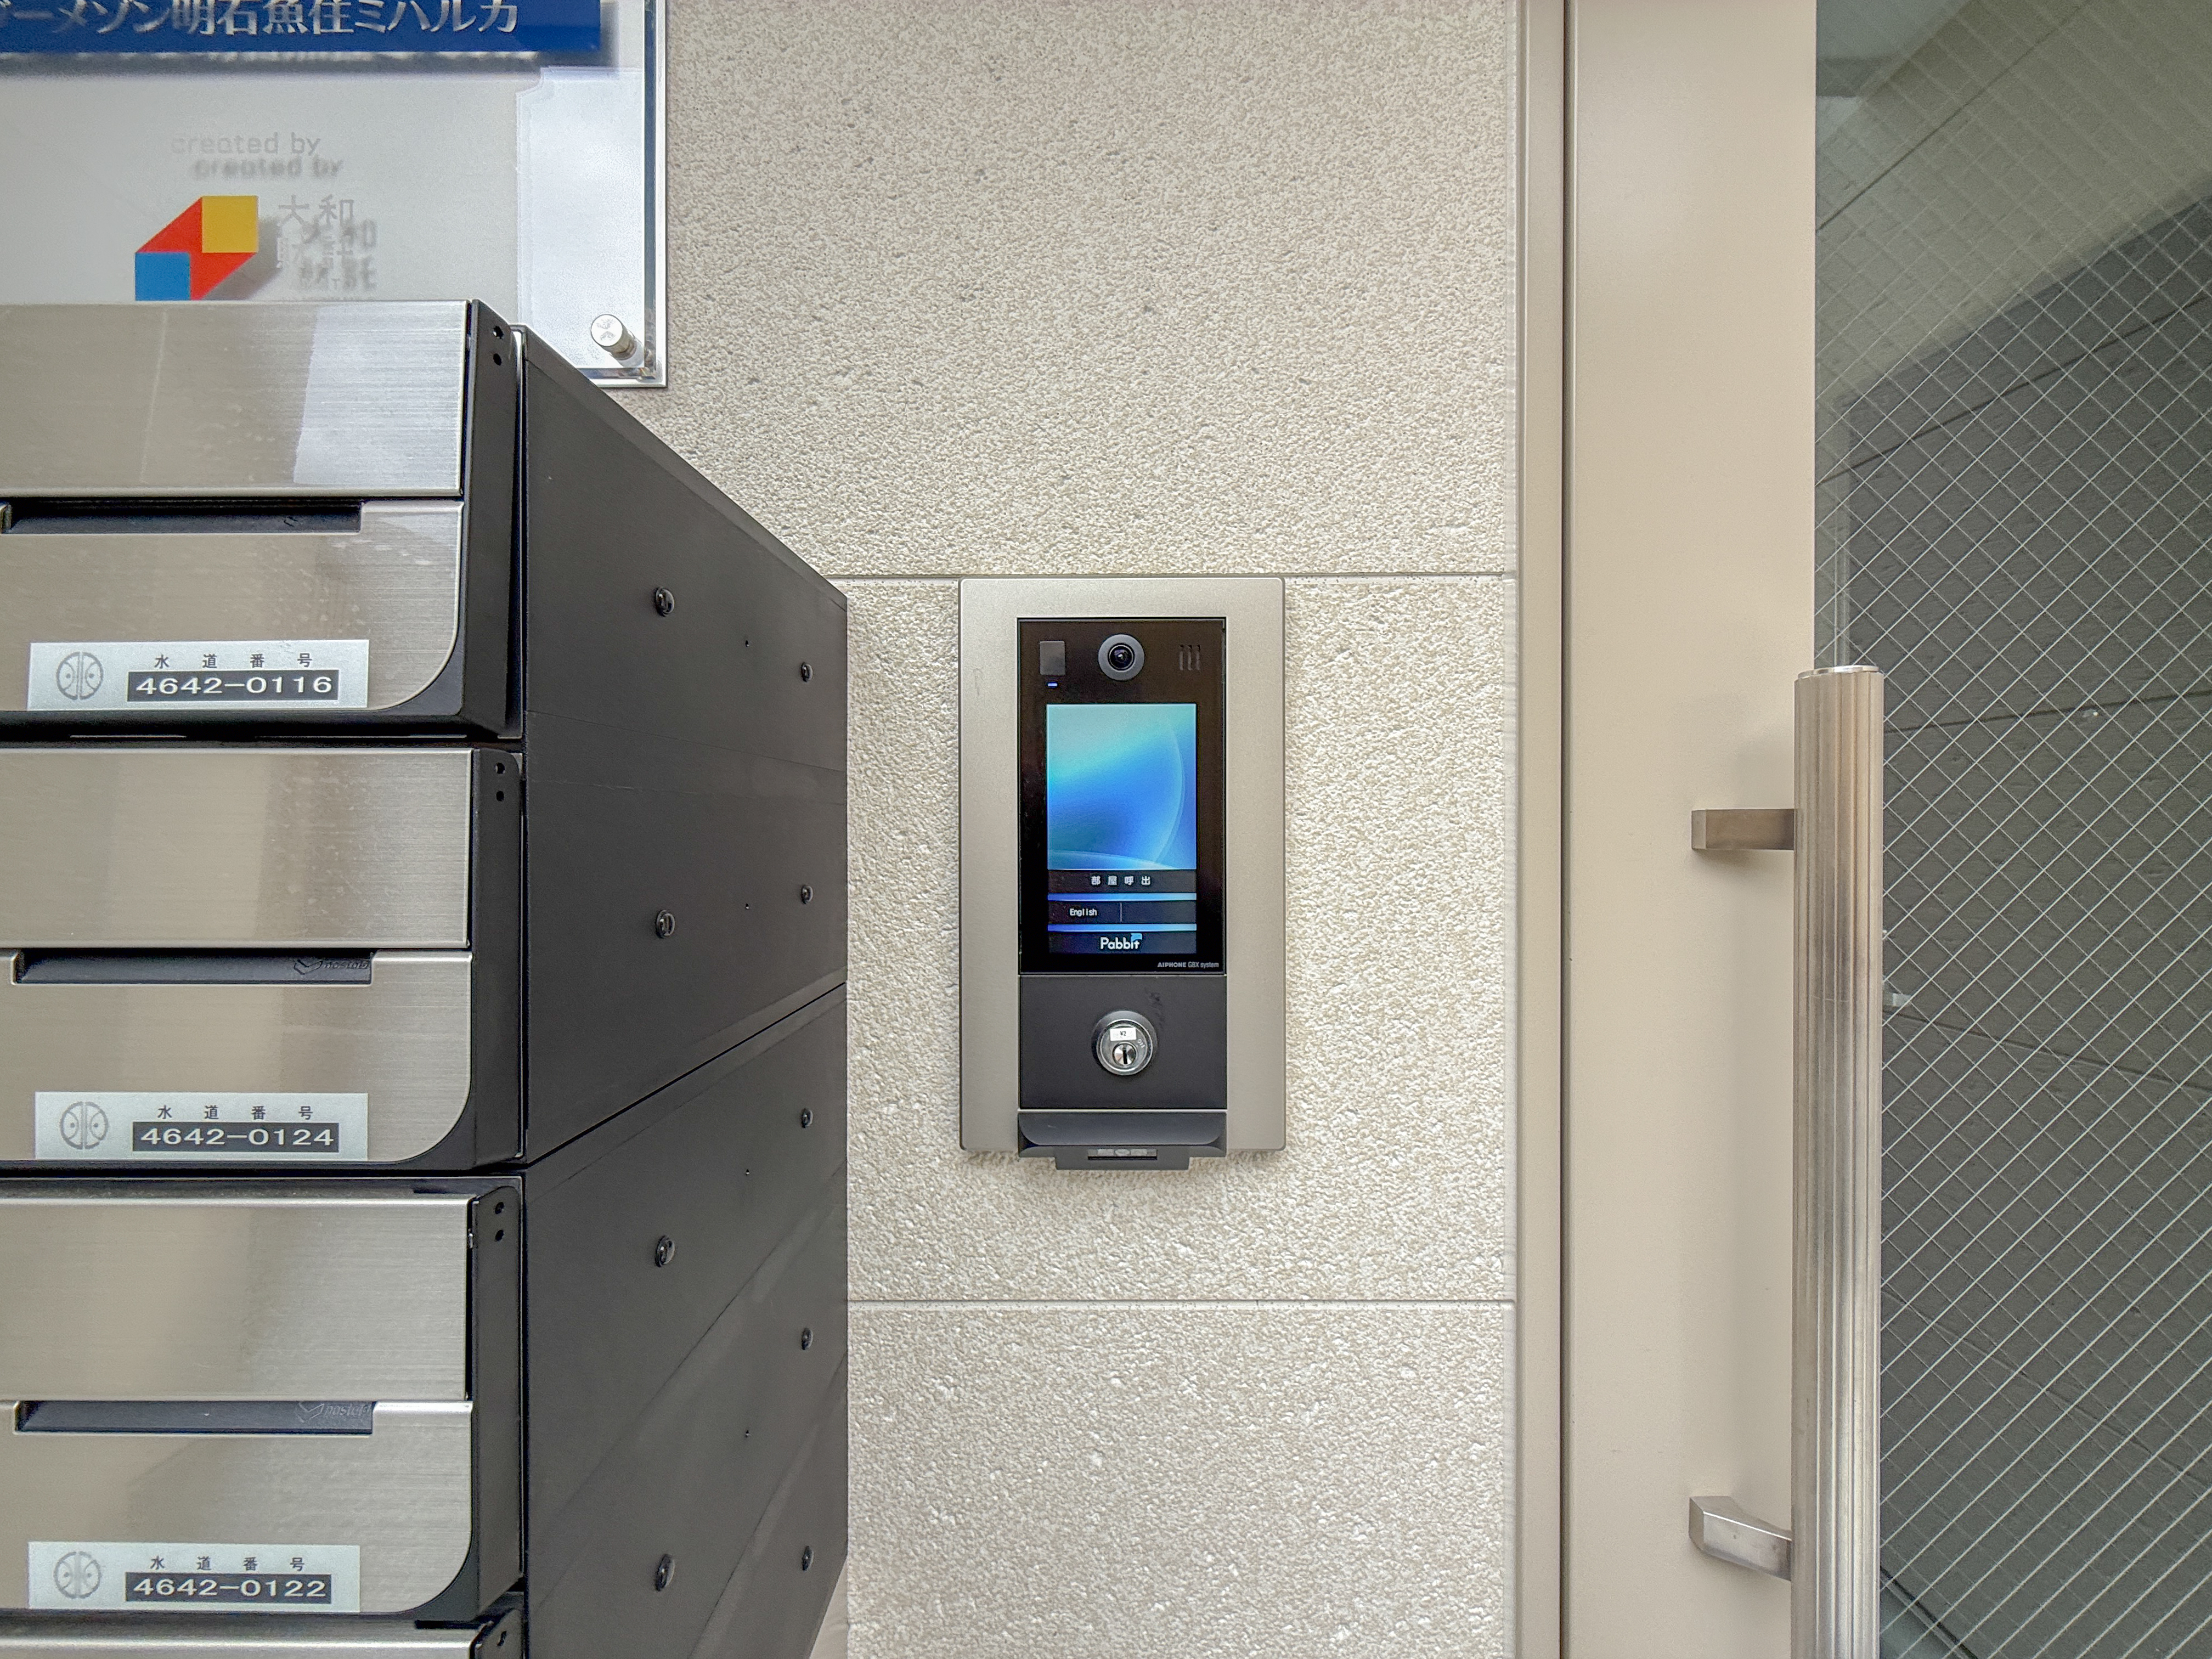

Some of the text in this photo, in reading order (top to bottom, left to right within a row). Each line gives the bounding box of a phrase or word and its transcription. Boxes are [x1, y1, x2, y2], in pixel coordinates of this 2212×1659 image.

[171, 132, 320, 156] created by
[154, 653, 313, 669] 水道番号
[136, 676, 332, 695] 4642-0116
[1070, 908, 1097, 917] English
[1100, 935, 1141, 950] Pabbit
[157, 1104, 313, 1120] 水道番号
[140, 1128, 334, 1146] 4642-0124
[150, 1555, 305, 1572] 水道番号
[133, 1578, 326, 1597] 4642-0122
